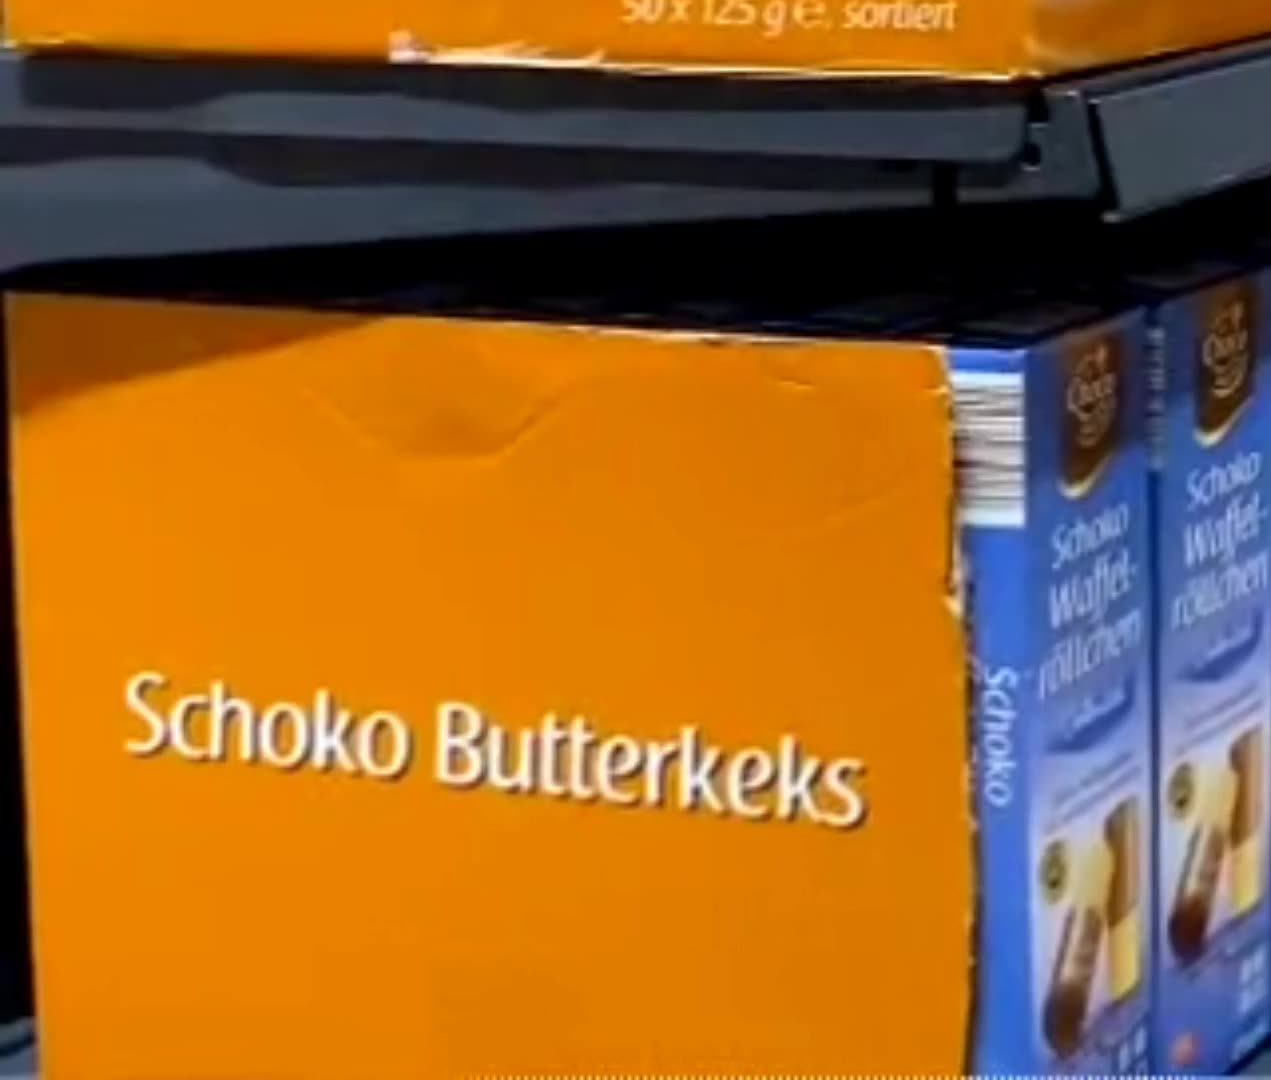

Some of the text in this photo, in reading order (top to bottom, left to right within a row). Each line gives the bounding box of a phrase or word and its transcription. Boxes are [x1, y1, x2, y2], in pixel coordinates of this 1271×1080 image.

[123, 670, 869, 828] Schoko Butterkeks
[981, 665, 1019, 808] Schoko
